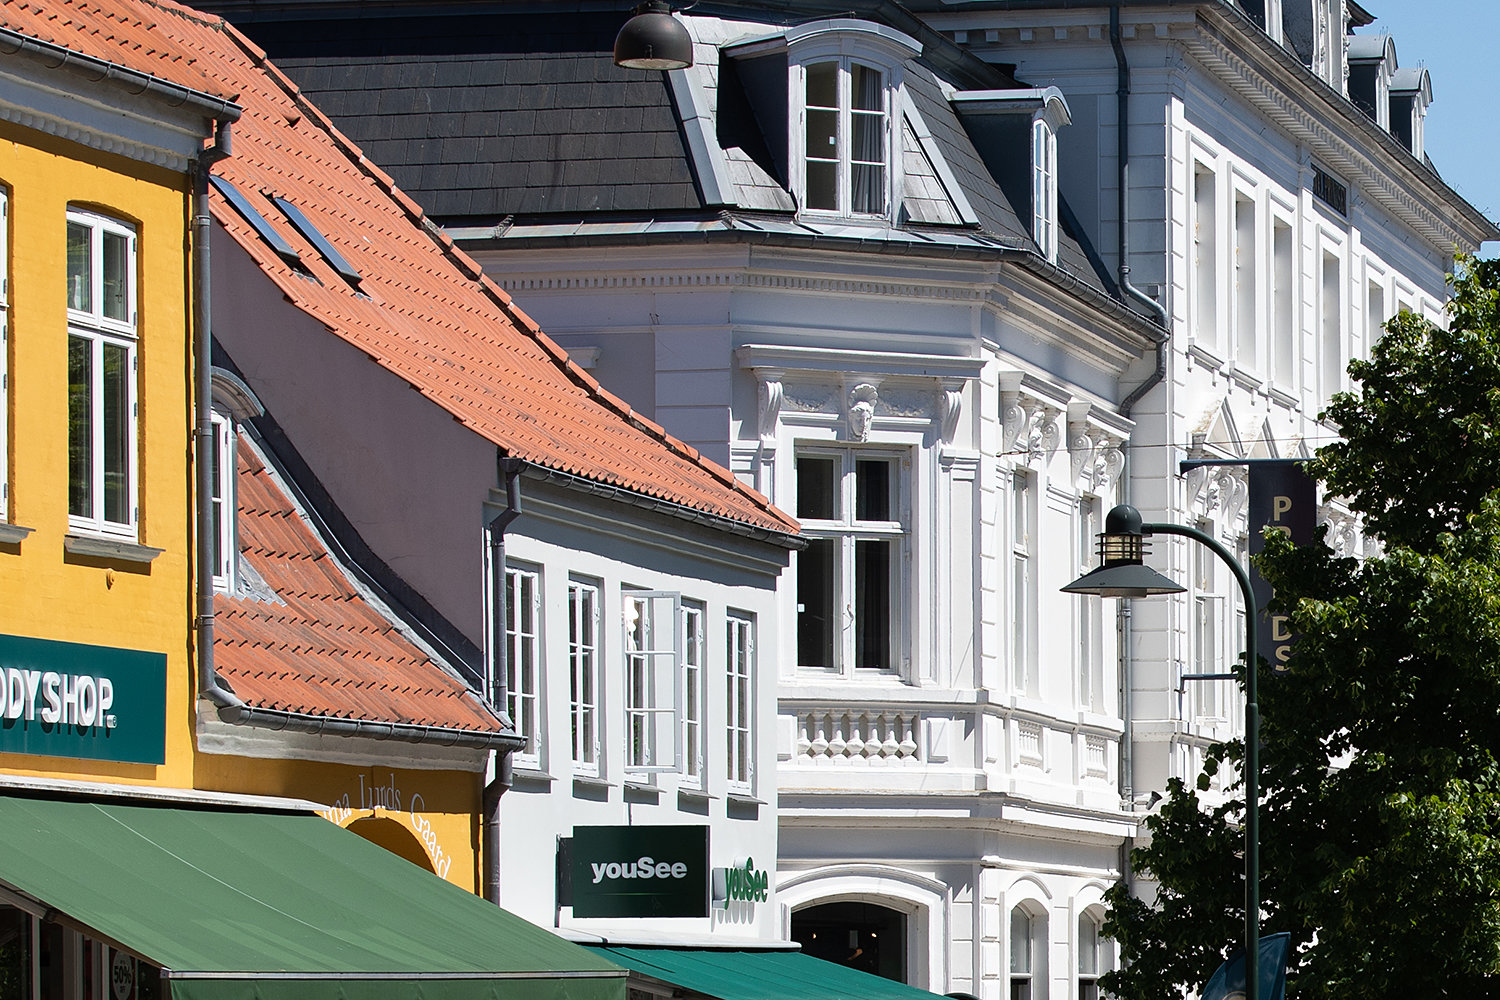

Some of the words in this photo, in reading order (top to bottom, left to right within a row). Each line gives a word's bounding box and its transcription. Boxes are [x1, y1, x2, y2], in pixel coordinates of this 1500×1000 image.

[358, 773, 401, 813] Lunds
[410, 793, 452, 880] Gaard
[591, 857, 687, 883] youSee
[724, 857, 768, 911] youSee
[114, 965, 132, 984] 50%
